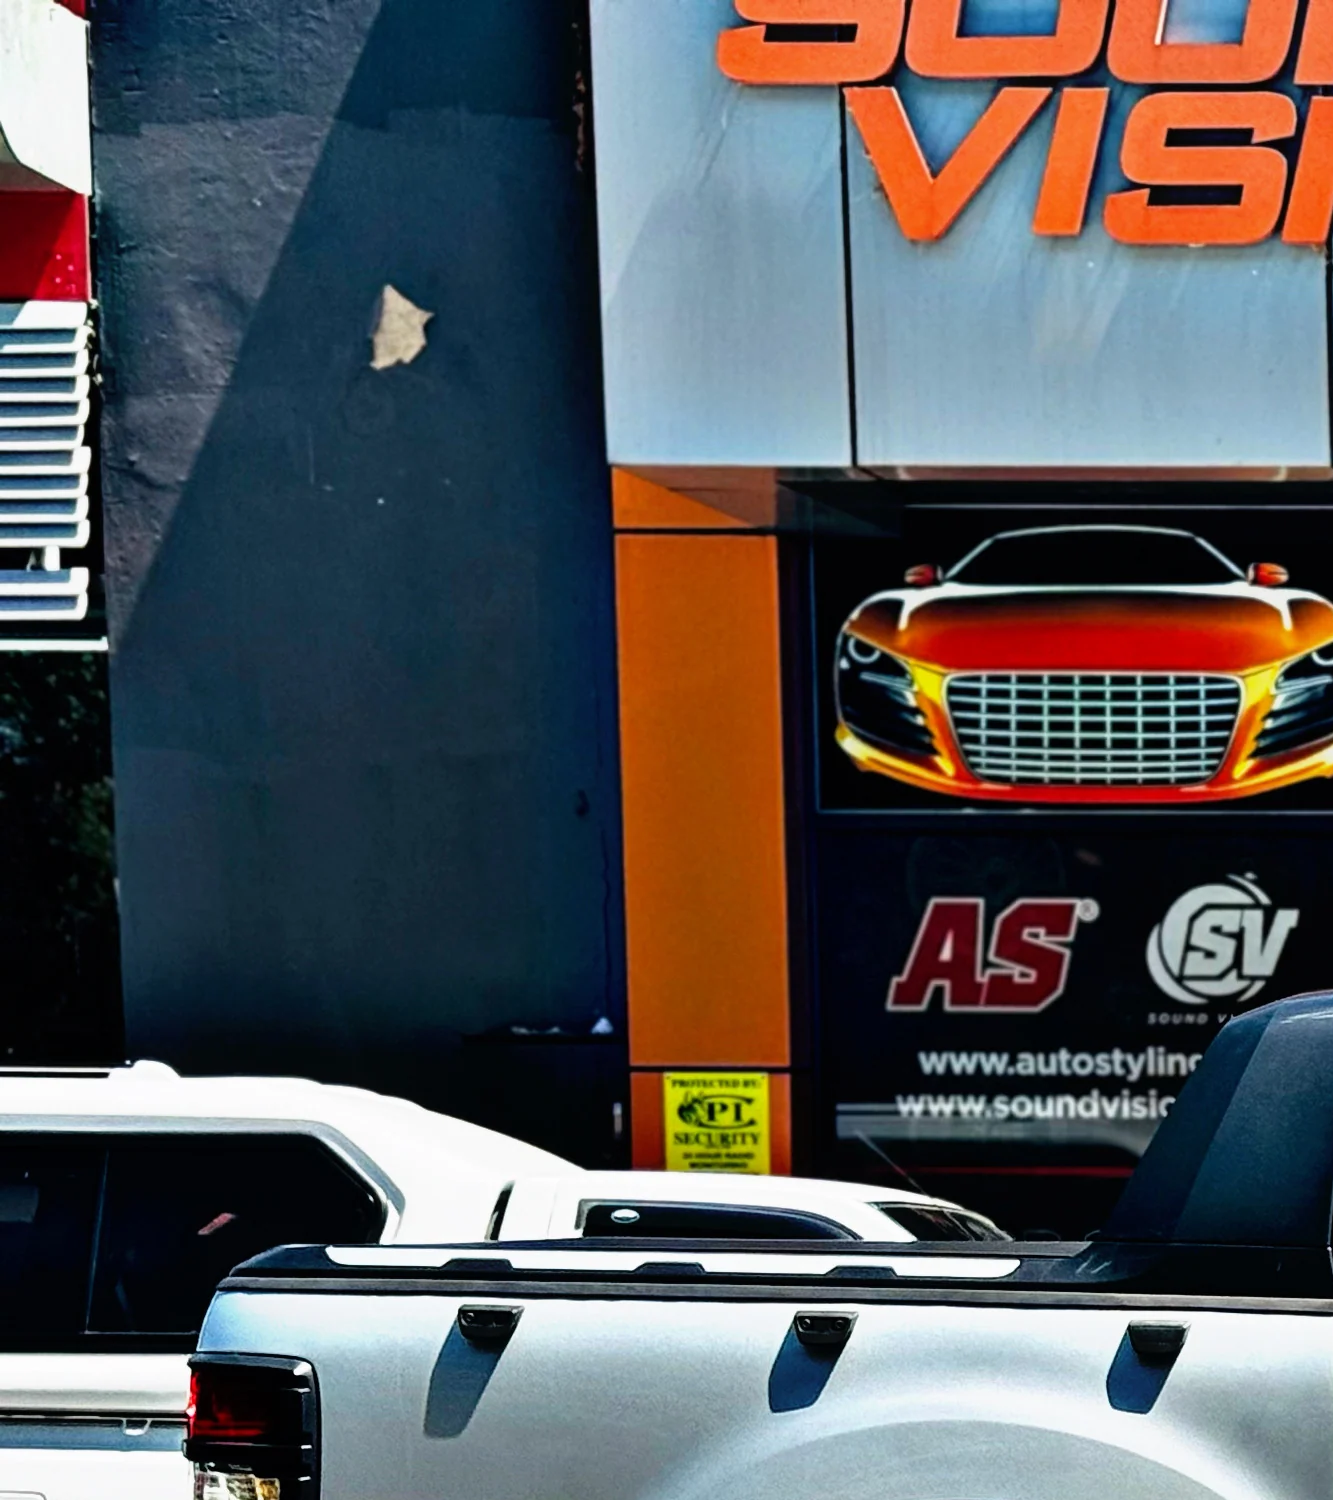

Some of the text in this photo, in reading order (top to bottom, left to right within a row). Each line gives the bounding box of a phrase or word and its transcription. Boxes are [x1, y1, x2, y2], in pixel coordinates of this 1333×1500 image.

[1180, 909, 1302, 980] SV
[1147, 1012, 1209, 1025] SOUND
[673, 1132, 760, 1146] SECURITY
